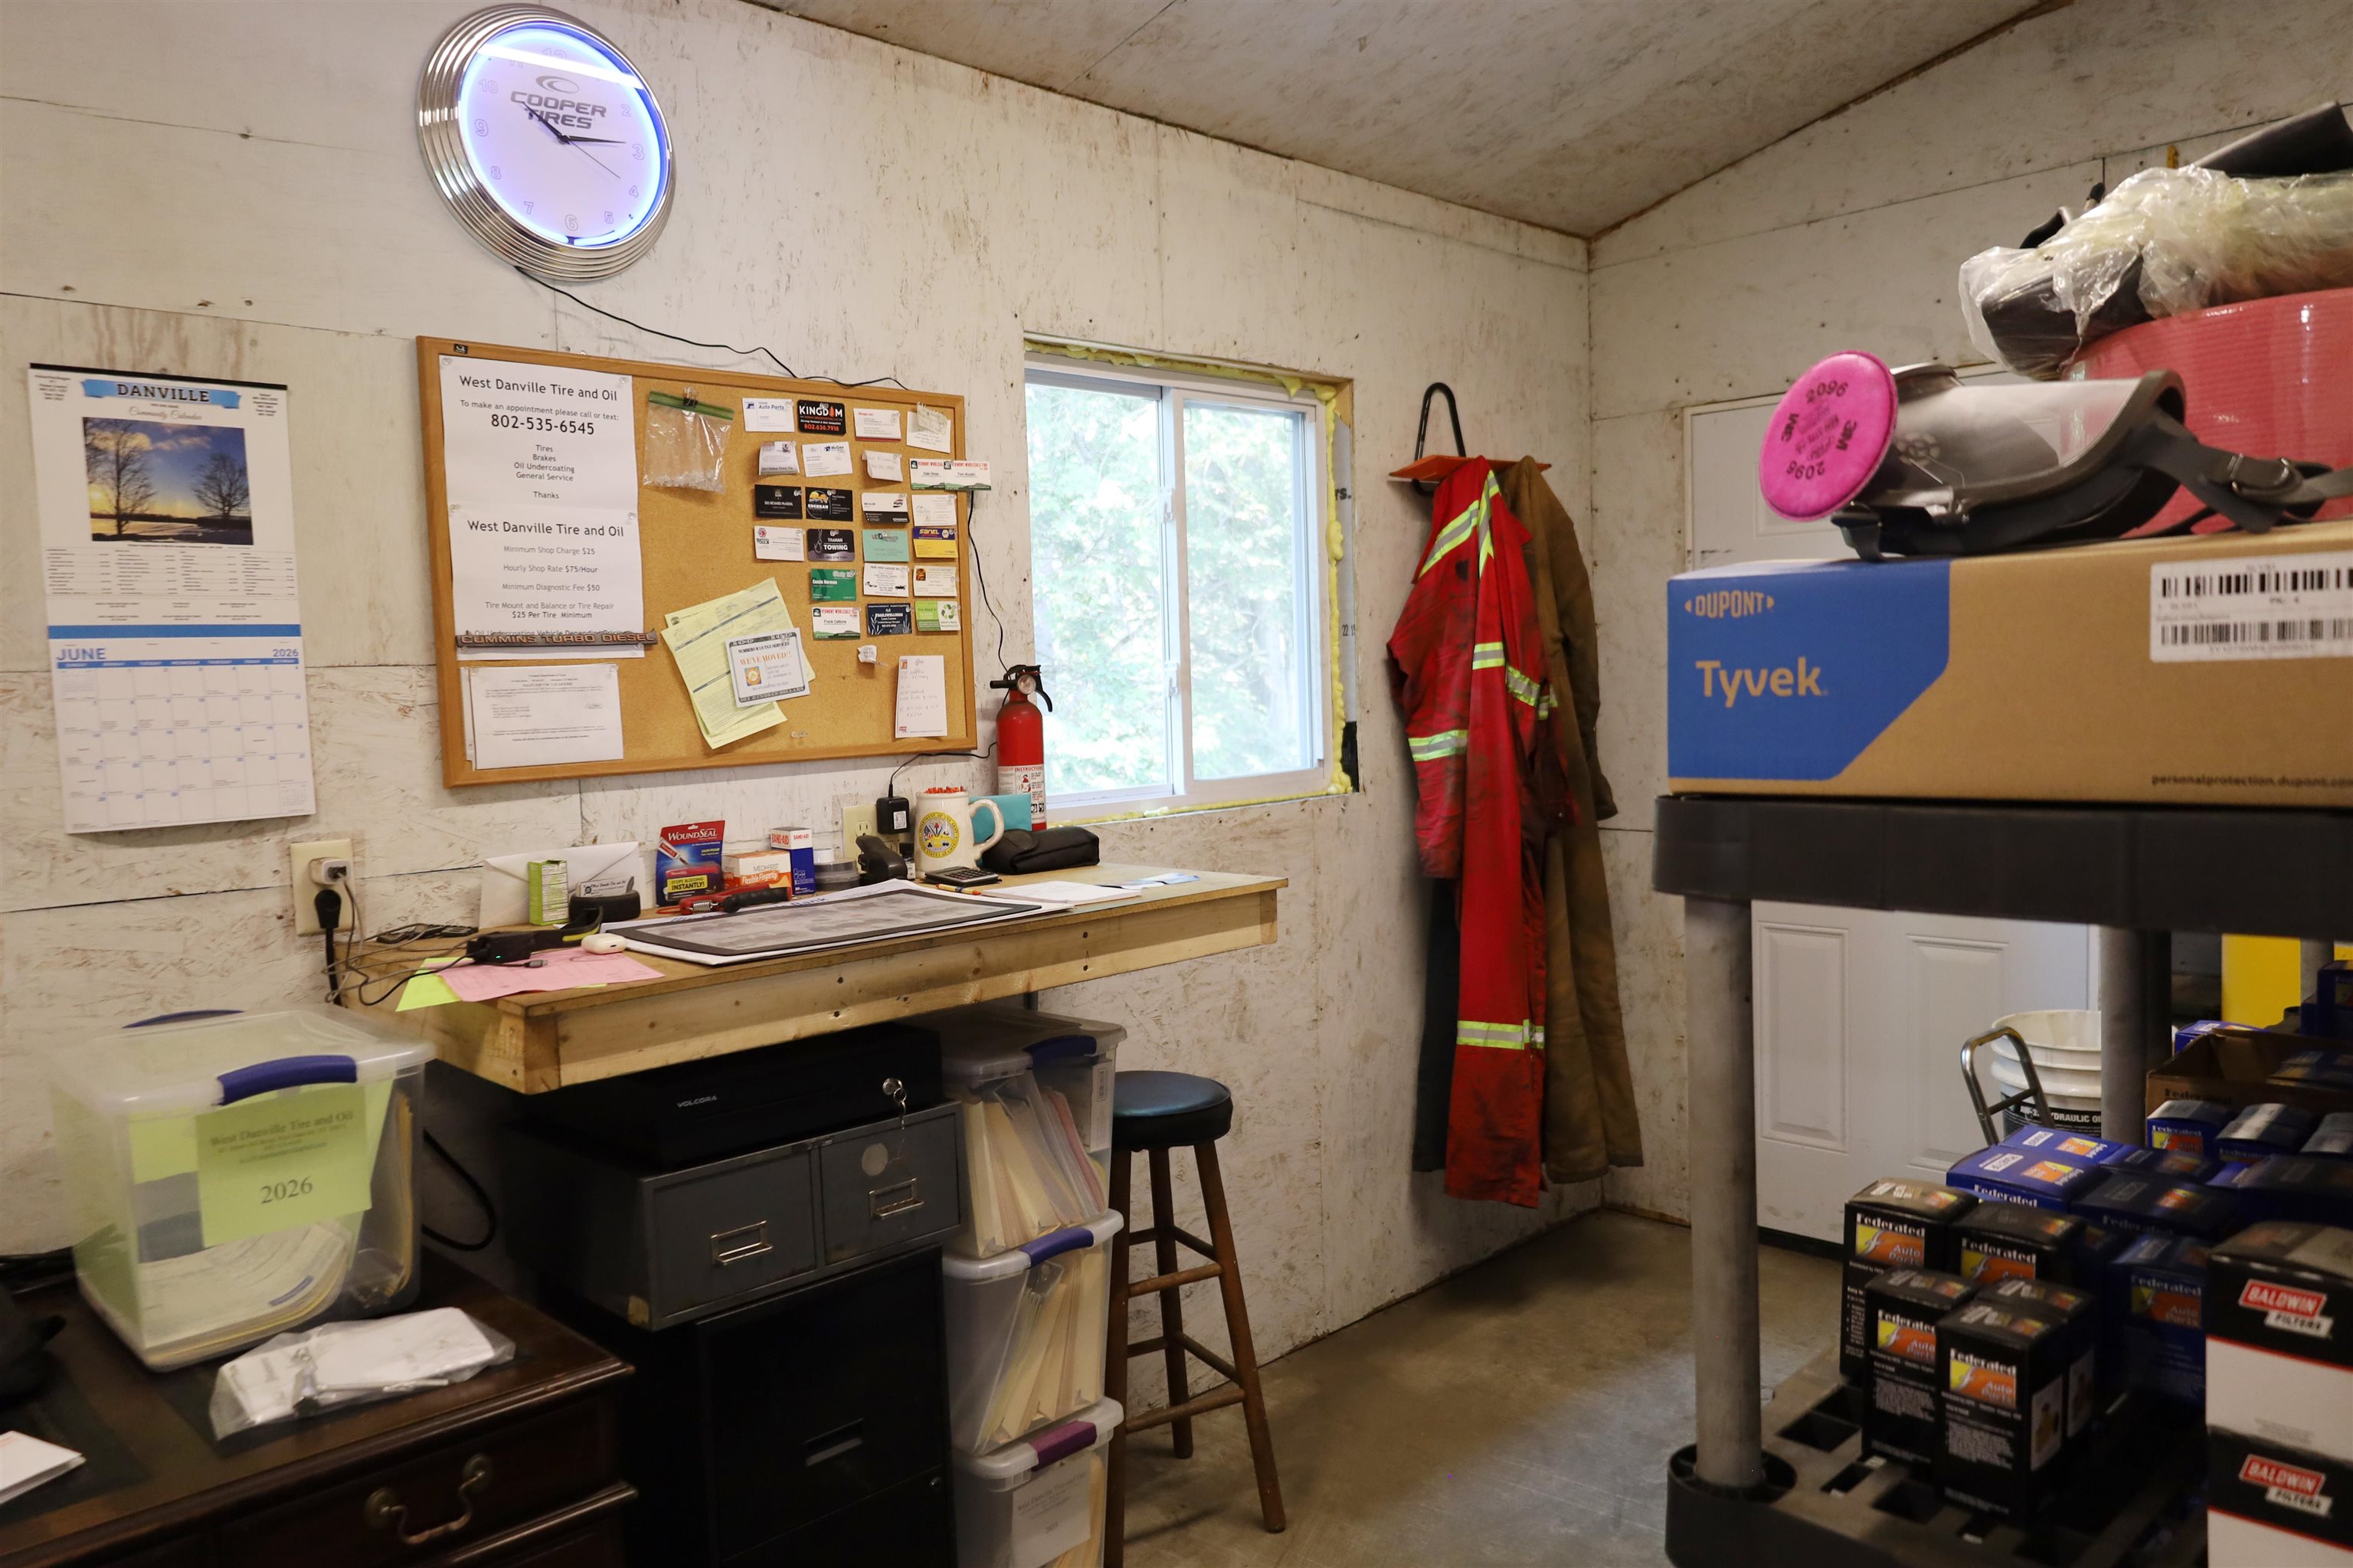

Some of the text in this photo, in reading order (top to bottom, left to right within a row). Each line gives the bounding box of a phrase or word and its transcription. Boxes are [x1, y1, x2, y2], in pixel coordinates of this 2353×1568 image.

[479, 79, 497, 93] 10
[511, 90, 607, 118] COOPER
[621, 103, 631, 117] 2
[525, 106, 592, 129] TIRES
[475, 119, 488, 137] 9
[632, 143, 644, 161] 3
[490, 166, 501, 179] 8
[628, 185, 639, 198] 4
[524, 201, 534, 214] 7
[565, 214, 578, 231] 6
[604, 211, 614, 224] 5
[117, 384, 210, 402] DANVILLE
[460, 375, 617, 401] West Danville Tire and Oil
[1806, 380, 1848, 404] 2096
[472, 401, 492, 409] make
[506, 404, 553, 414] appointment
[555, 408, 578, 417] please
[580, 410, 591, 418] call
[491, 414, 594, 434] 802-535-6545
[533, 453, 556, 462] Brakes
[527, 463, 574, 473] Undercoating
[467, 520, 623, 536] West Danville Tire and Oil
[538, 546, 555, 555] Shop
[556, 547, 580, 555] Charge
[582, 547, 595, 555] $25
[565, 565, 597, 574] $75/Hour
[536, 584, 570, 592] Diagnostic
[594, 603, 614, 611] Repair
[1695, 590, 1765, 618] DUPONT
[461, 633, 655, 644] CUMMINS TURBO DIESEL
[56, 647, 299, 660] JUNE 2026
[762, 651, 791, 662] MOVED!!
[1695, 656, 1822, 708] Tyvek
[772, 833, 789, 845] BAND-AID
[759, 872, 777, 882] Fingertip
[672, 882, 705, 890] INSTANTLY!
[676, 1095, 717, 1108] VOLCORA
[2051, 1112, 2090, 1122] DRAULIC
[240, 1124, 286, 1140] Danville
[290, 1119, 311, 1130] Tire
[314, 1115, 333, 1126] and
[335, 1111, 353, 1122] Oil
[260, 1176, 313, 1205] 2026
[1975, 1185, 2037, 1208] Federated
[1856, 1213, 1926, 1238] Federated
[1894, 1243, 1921, 1256] Auto
[1962, 1237, 2037, 1264] Federated
[2132, 1275, 2201, 1296] Federated
[2247, 1285, 2317, 1314] BALDWIN
[2165, 1311, 2198, 1325] Parts
[2169, 1305, 2198, 1316] Auto
[2276, 1314, 2321, 1330] FILTERS
[1949, 1347, 2017, 1374] Federated
[1982, 1387, 2011, 1404] Parts
[1986, 1381, 2012, 1394] Auto
[2247, 1462, 2317, 1494] BALDWIN
[2275, 1491, 2322, 1511] FILTERS
